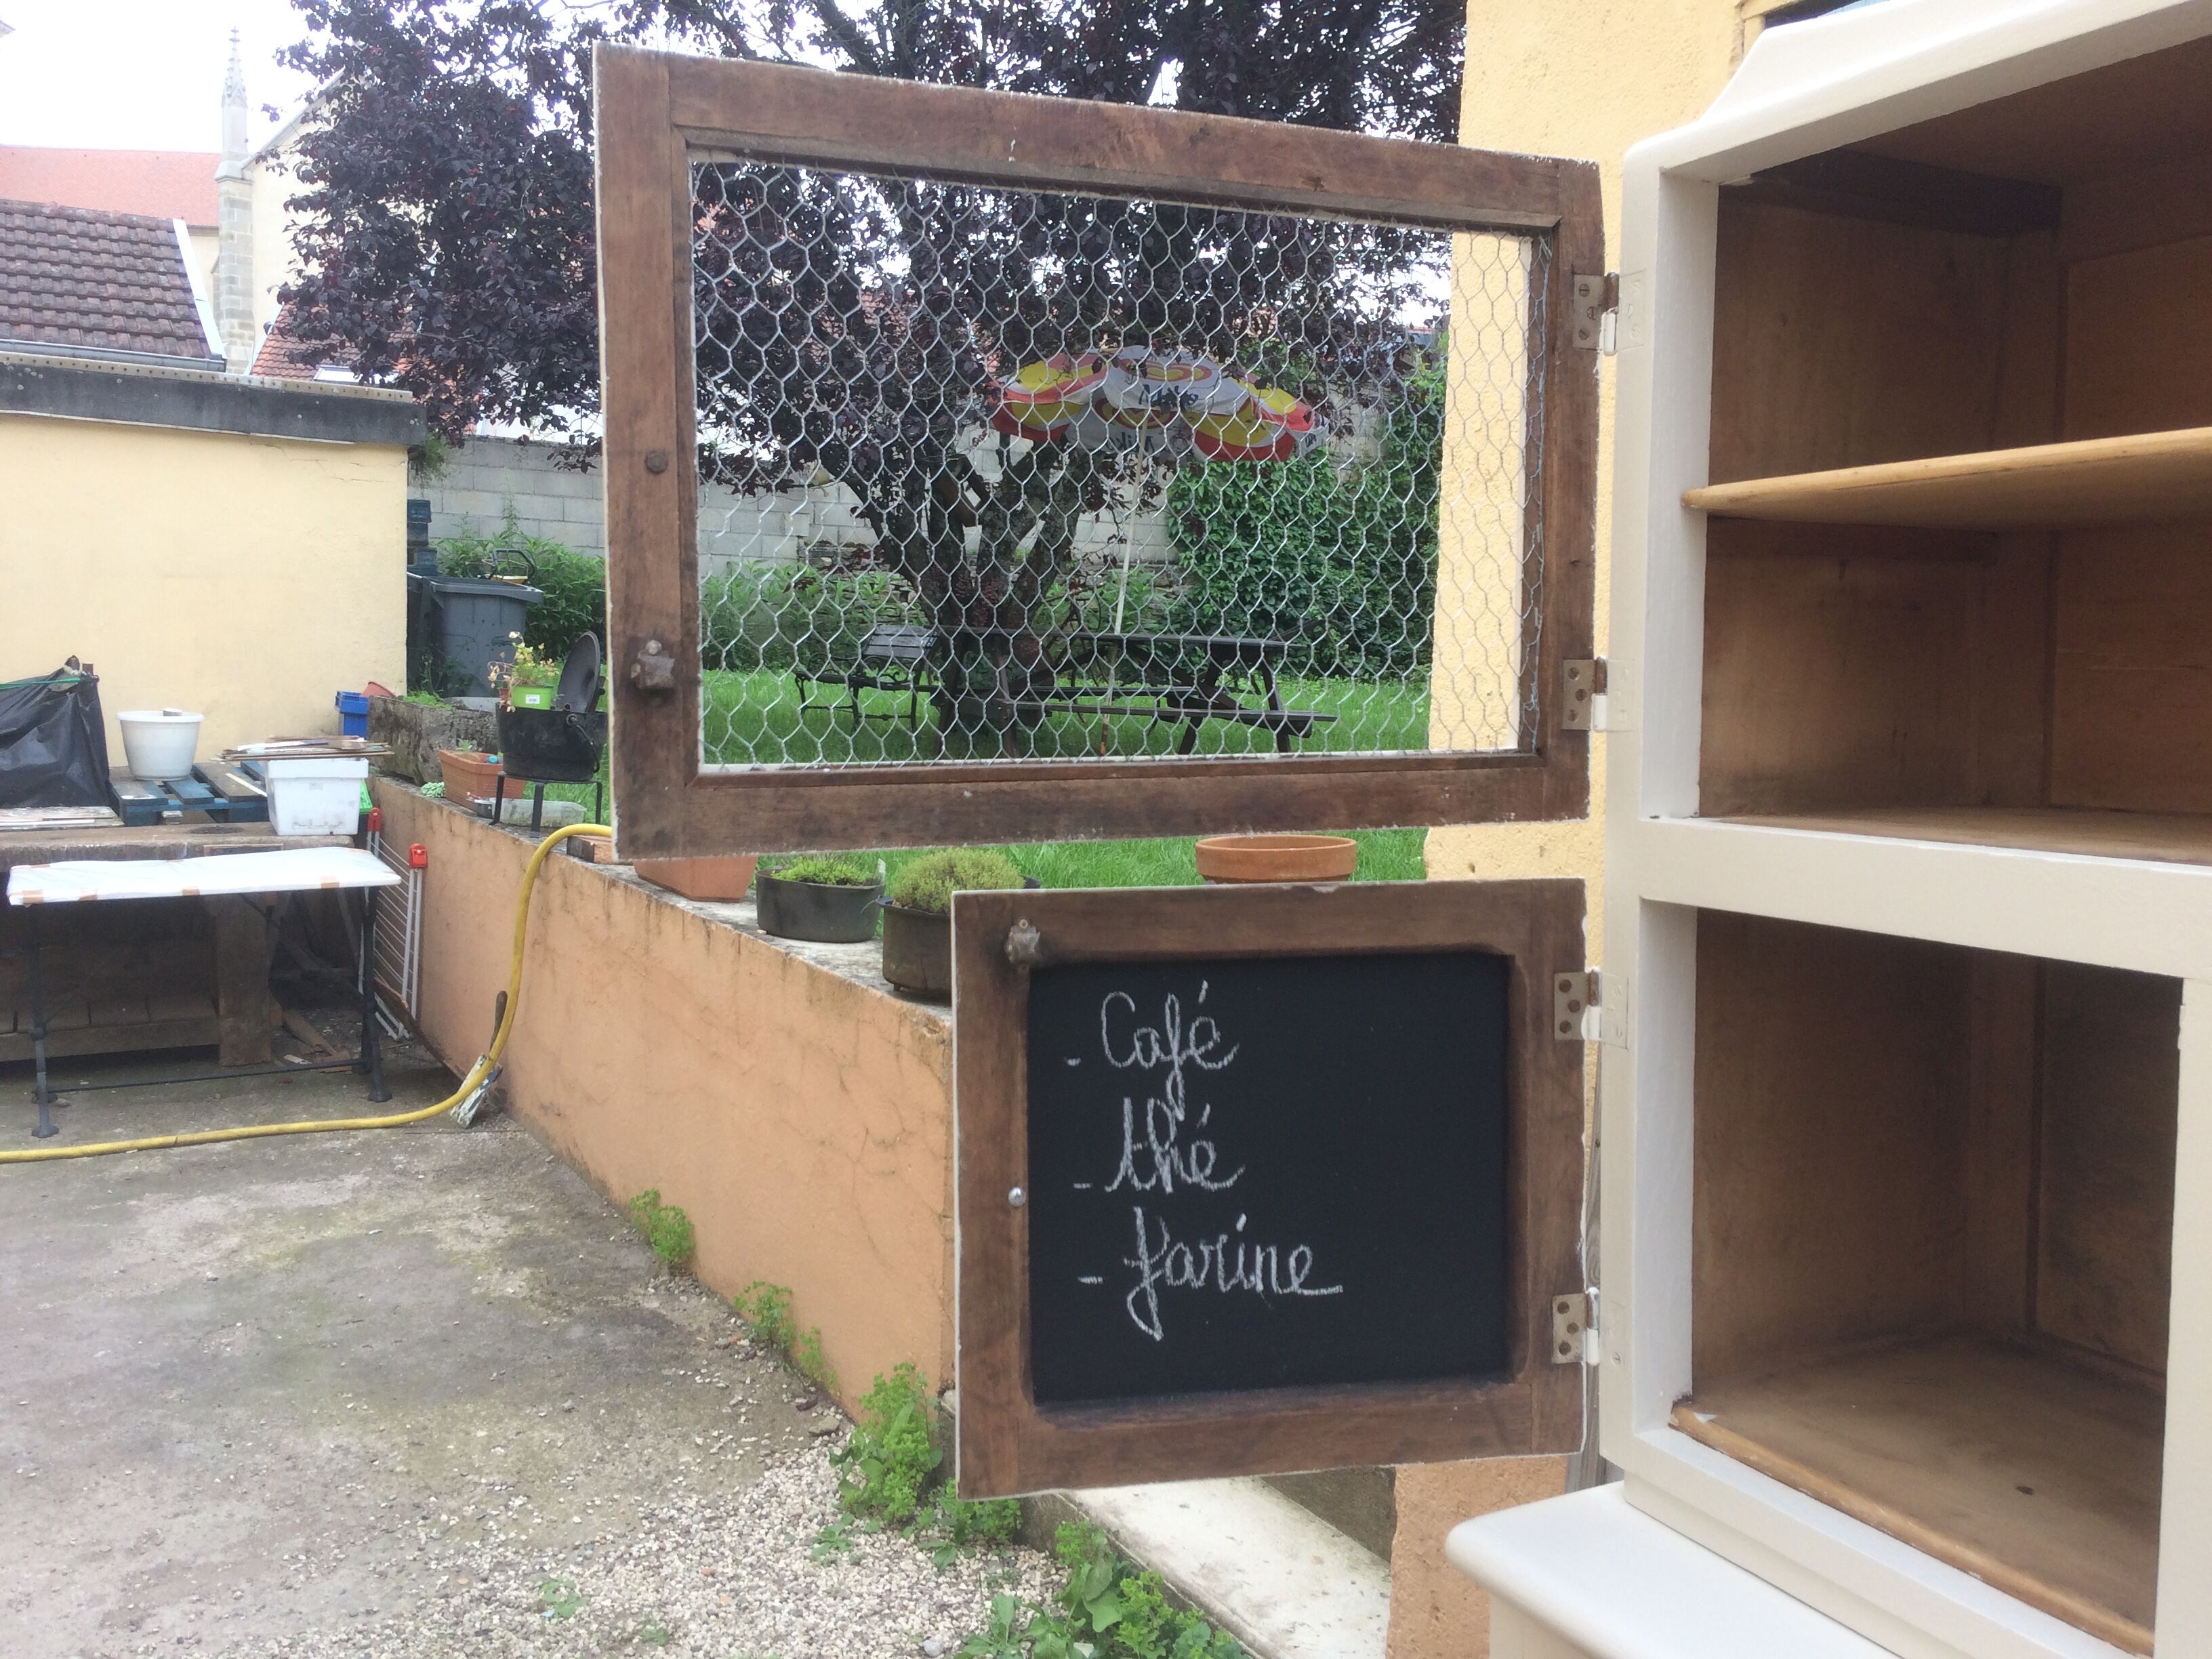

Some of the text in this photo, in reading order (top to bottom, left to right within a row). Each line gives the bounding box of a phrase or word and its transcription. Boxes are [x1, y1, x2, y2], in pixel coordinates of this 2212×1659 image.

[1139, 384, 1198, 407] Mo
[1101, 979, 1240, 1122] Café
[1124, 1206, 1344, 1342] farine
